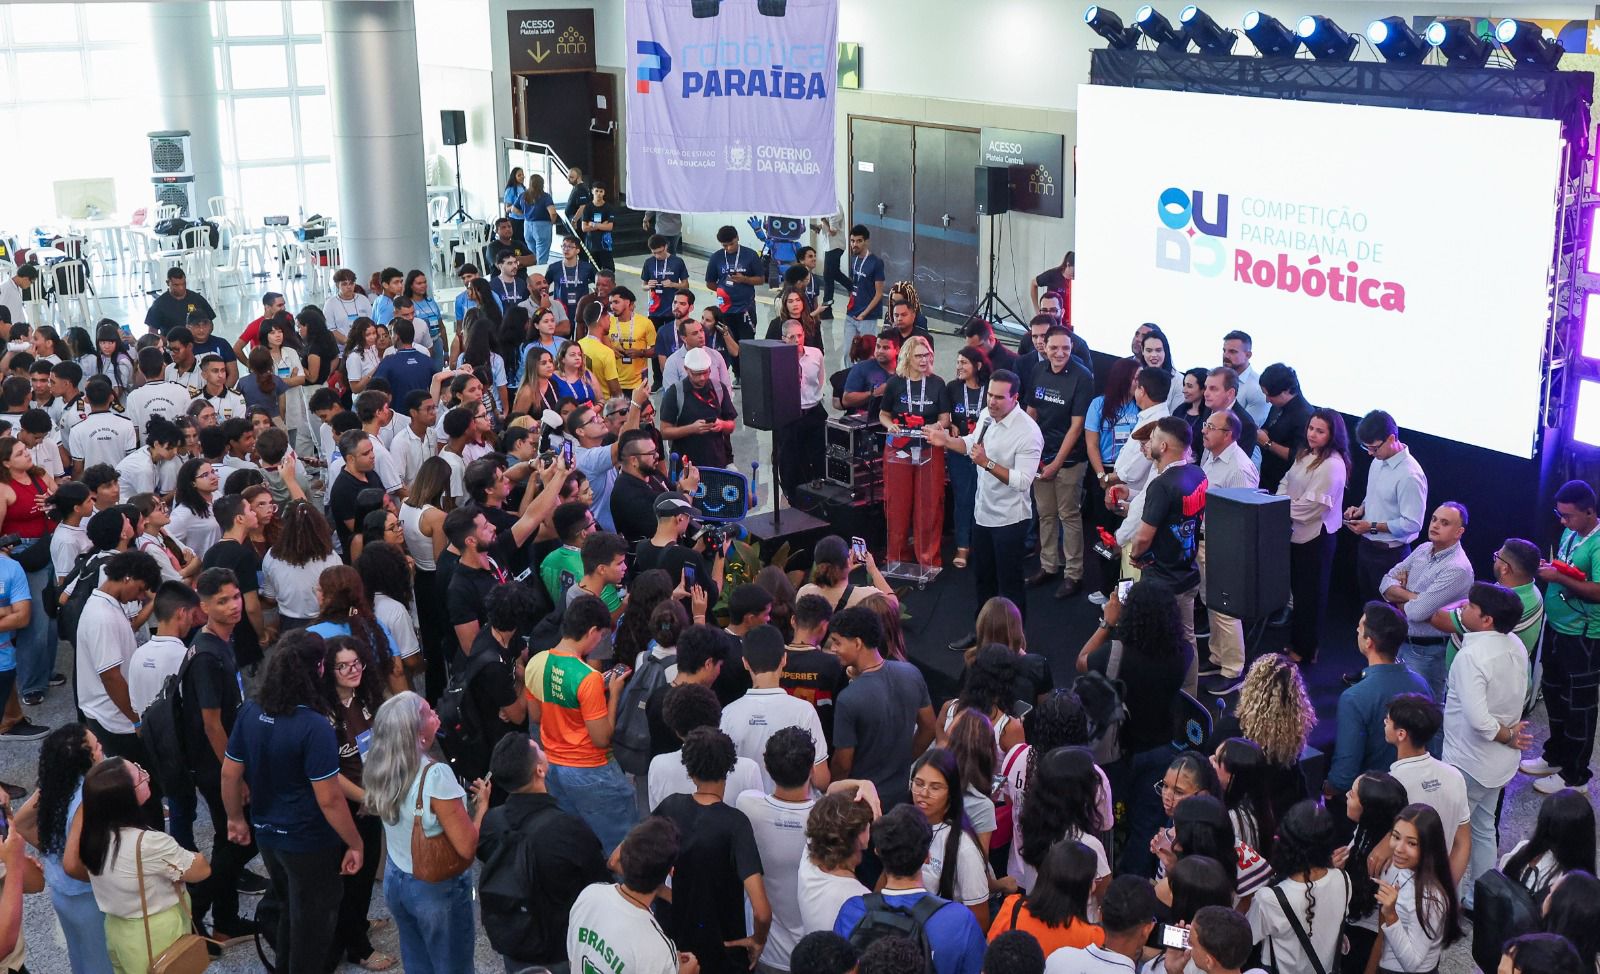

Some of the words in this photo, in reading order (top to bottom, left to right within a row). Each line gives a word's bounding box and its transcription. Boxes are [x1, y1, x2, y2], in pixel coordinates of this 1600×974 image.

[520, 20, 555, 28] ACESSO
[681, 36, 826, 68] robótica
[756, 145, 812, 161] GOVERNO
[988, 140, 1022, 154] ACESSO
[756, 160, 774, 172] DA
[774, 160, 820, 174] PARAÍBA
[1004, 156, 1024, 165] Central
[1241, 196, 1368, 234] COMPETIÇÃO
[1240, 224, 1348, 257] PARAIBANA
[1357, 241, 1384, 263] DE
[1234, 248, 1406, 313] Robótica
